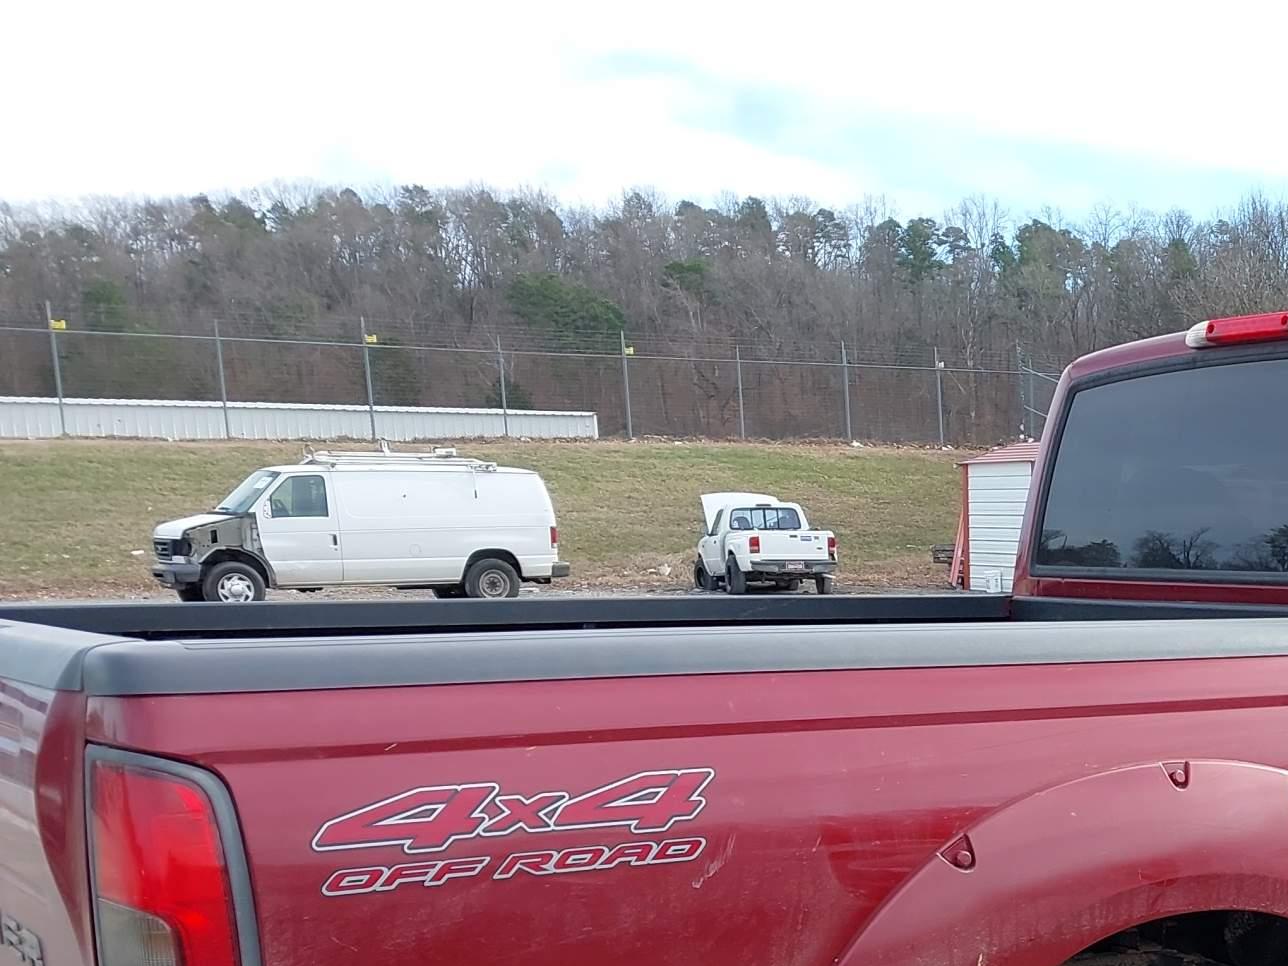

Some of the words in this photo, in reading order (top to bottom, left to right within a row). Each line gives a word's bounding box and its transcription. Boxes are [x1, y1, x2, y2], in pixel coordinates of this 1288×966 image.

[311, 767, 715, 854] 4x4
[321, 857, 489, 897] OFF
[494, 836, 707, 880] ROAD
